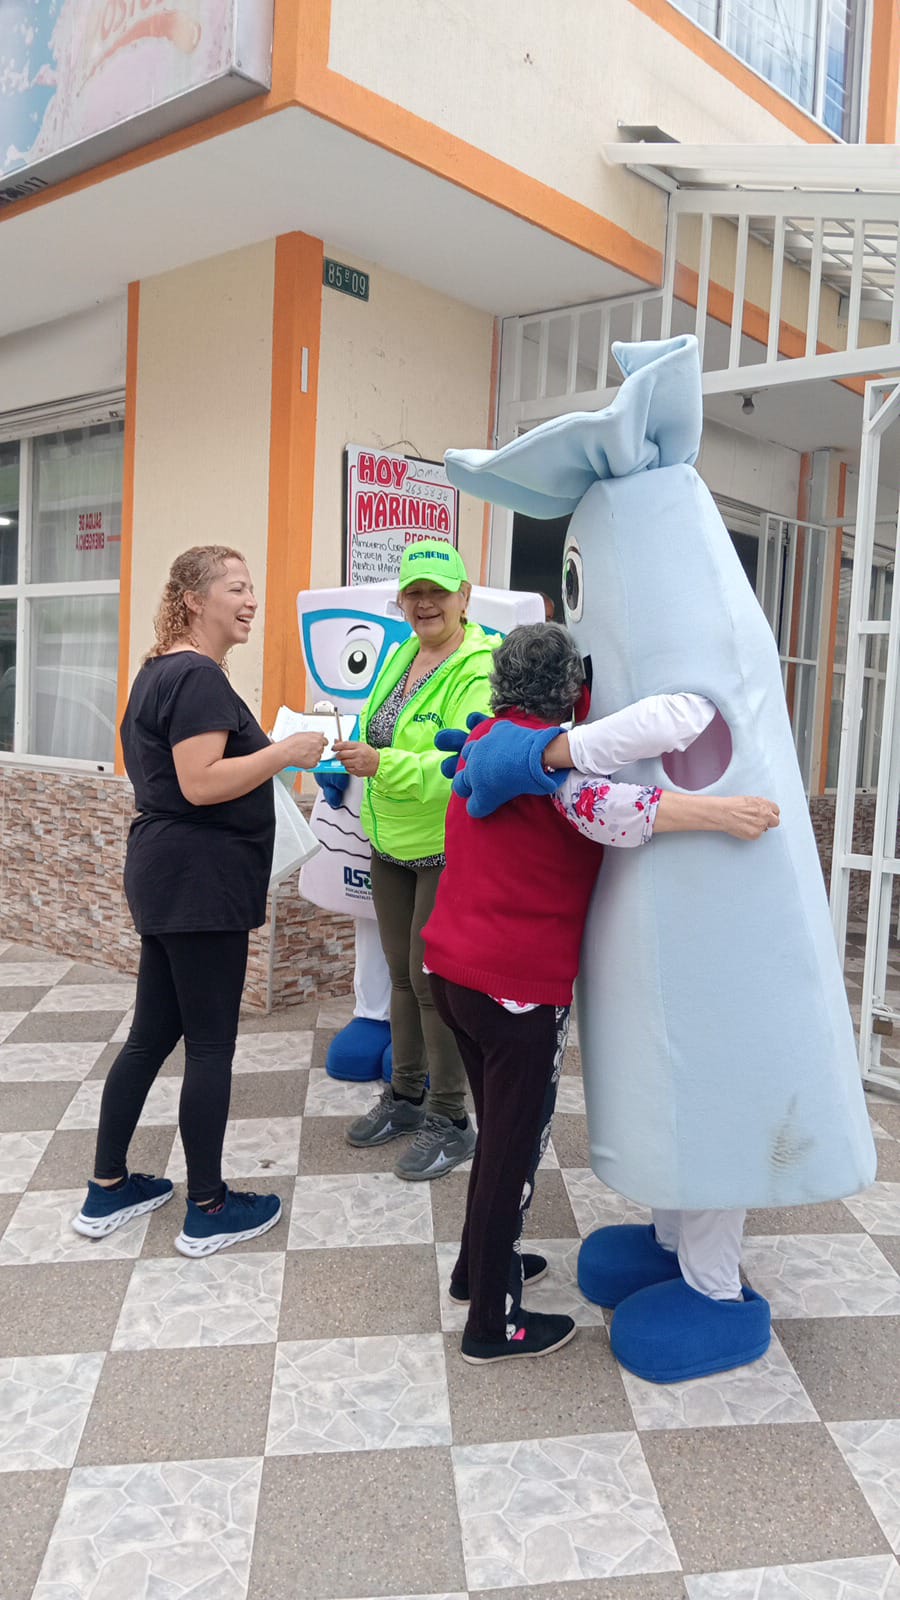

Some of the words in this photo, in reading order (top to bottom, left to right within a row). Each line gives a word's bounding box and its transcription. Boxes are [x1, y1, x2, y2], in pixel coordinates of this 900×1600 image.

[328, 263, 343, 287] 85
[352, 271, 366, 296] 09
[358, 452, 408, 489] HOY
[356, 491, 450, 534] MARINITA
